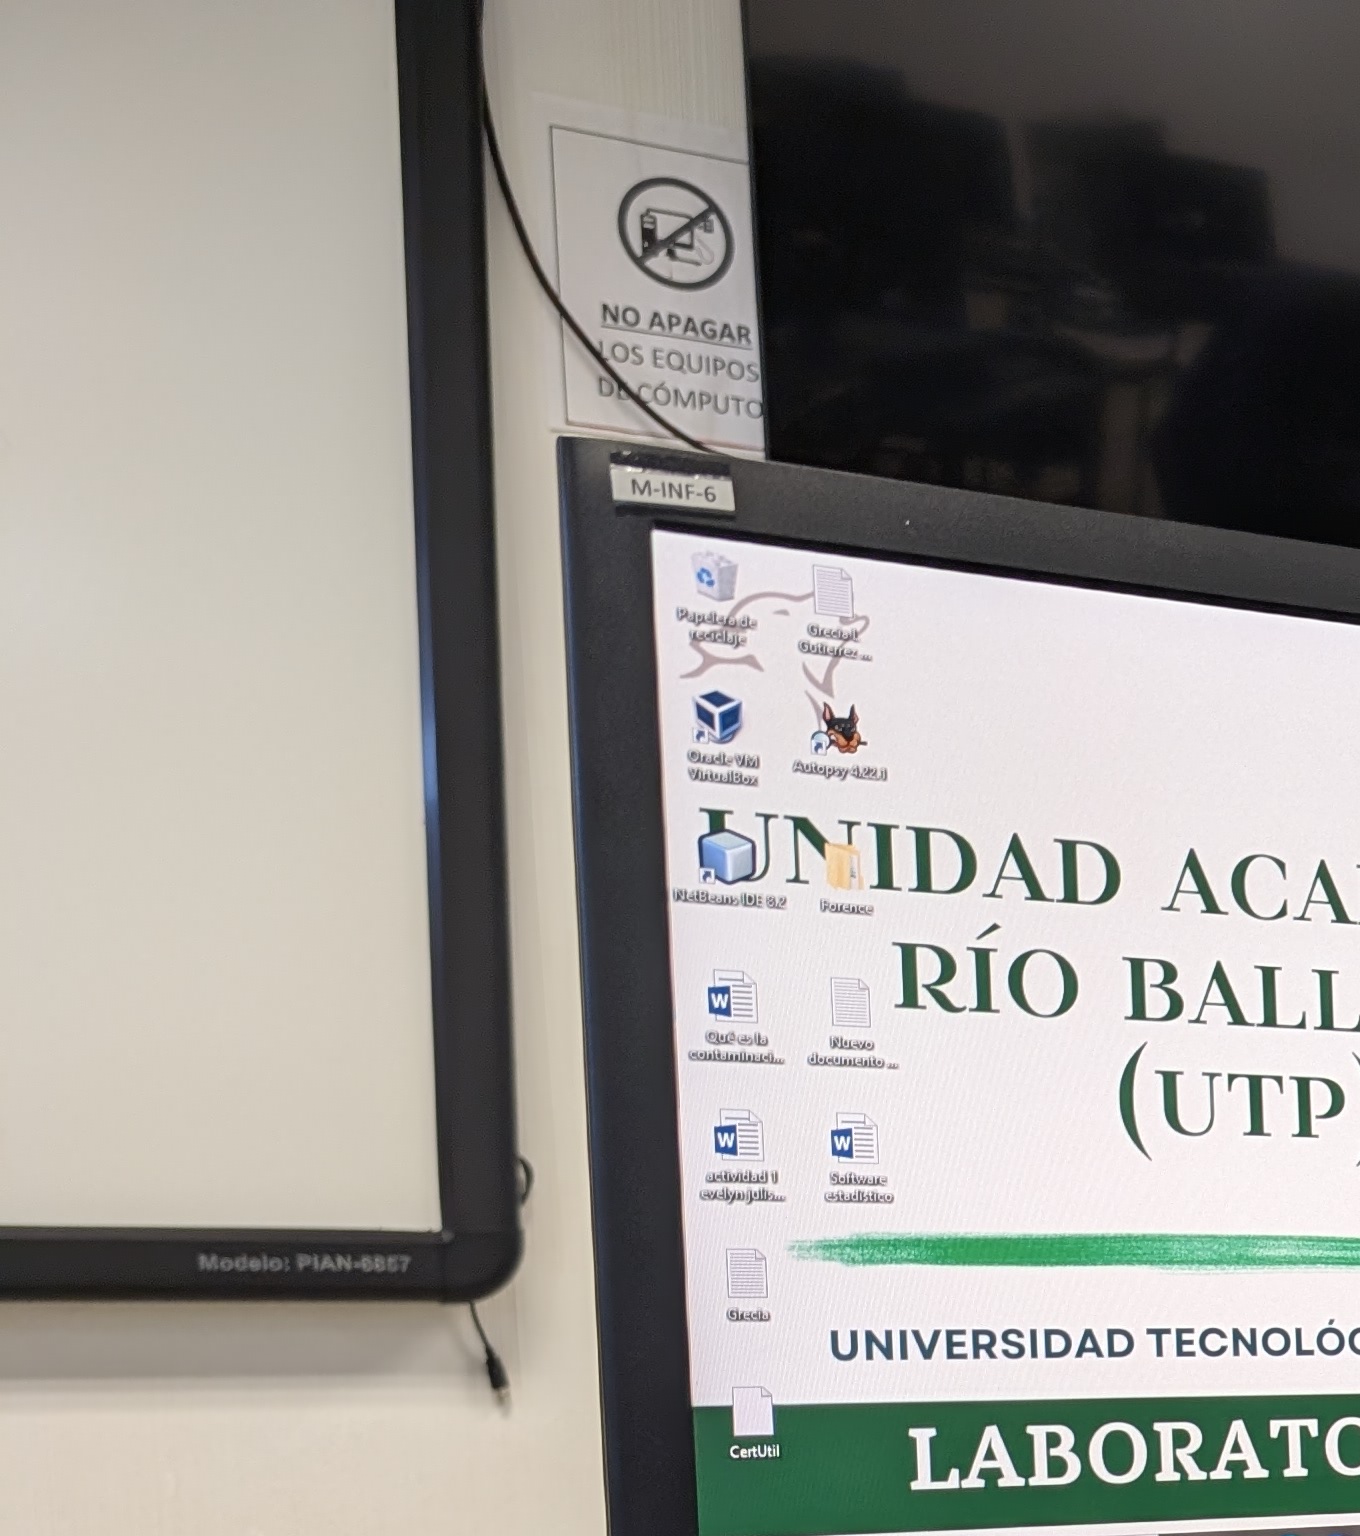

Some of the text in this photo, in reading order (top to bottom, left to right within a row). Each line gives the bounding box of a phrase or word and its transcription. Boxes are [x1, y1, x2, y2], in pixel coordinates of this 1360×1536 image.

[602, 302, 752, 344] NO APAGAR
[598, 341, 760, 383] LOS EQUIPOS
[637, 377, 765, 419] CÓMPUTO
[631, 478, 717, 503] M-INF-6
[676, 607, 757, 630] Papelera de
[689, 629, 748, 649] reciclaje
[806, 624, 850, 641] Grecia
[687, 749, 761, 769] Oracle VM
[687, 767, 760, 787] VirtualBox
[793, 759, 848, 783] Autopsy
[699, 807, 1123, 907] UNIDAD
[673, 887, 788, 910] NetBeans IDE 8.2
[819, 899, 874, 916] Forence
[892, 921, 1082, 1020] RÍO
[706, 1030, 769, 1047] Qué es la
[829, 1035, 875, 1051] Nuevo
[807, 1052, 885, 1069] documento
[705, 1169, 768, 1185] actividad
[830, 1171, 888, 1187] Software
[700, 1189, 746, 1205] evelyn
[196, 1253, 290, 1272] Modelo:
[726, 1307, 771, 1323] Grecia
[829, 1327, 1136, 1362] UNIVERSIDAD
[729, 1444, 781, 1460] CertUtil
